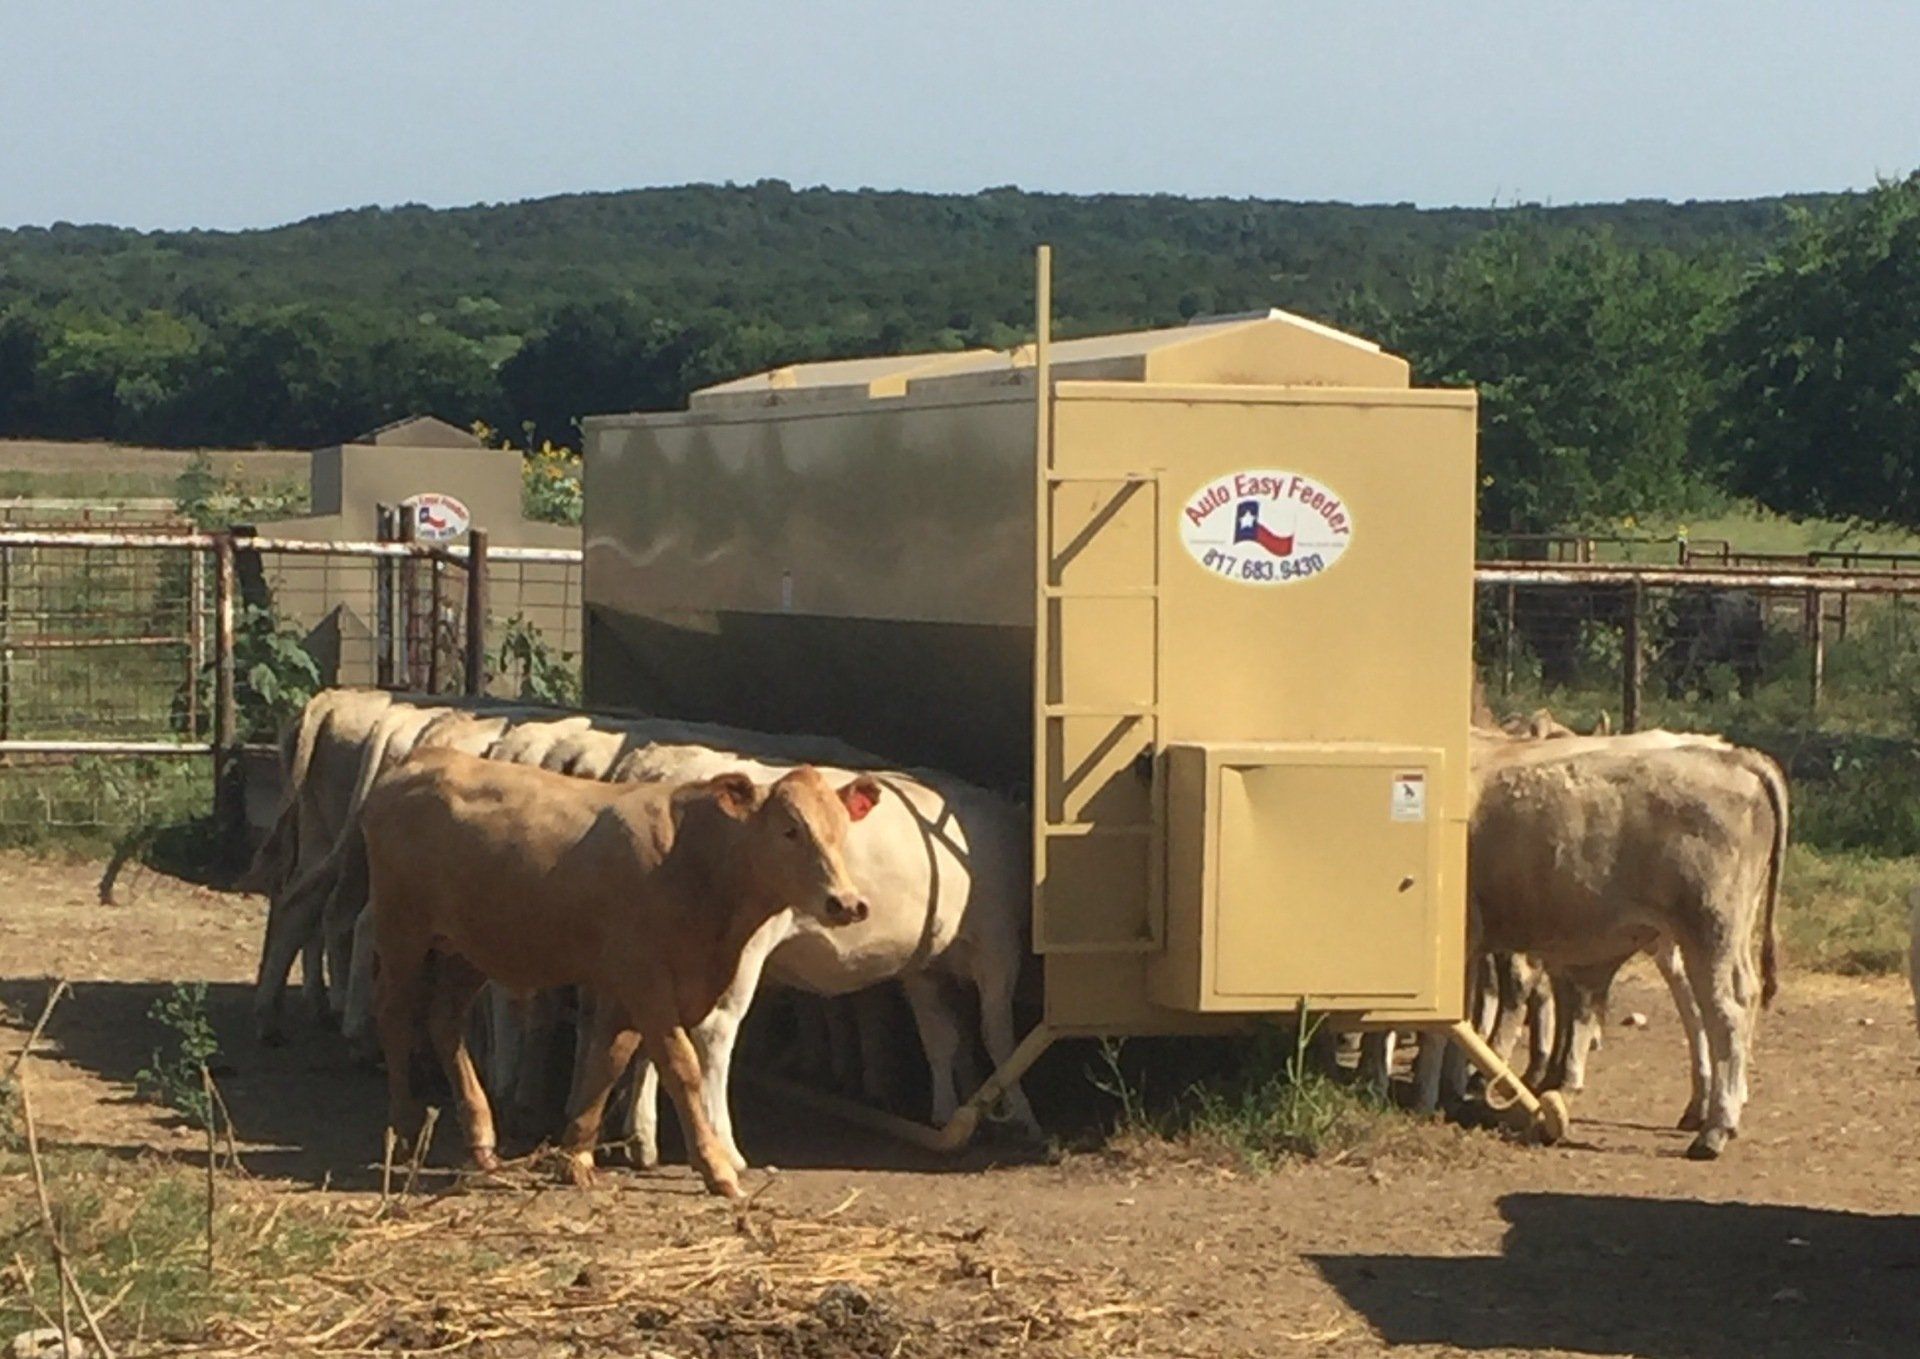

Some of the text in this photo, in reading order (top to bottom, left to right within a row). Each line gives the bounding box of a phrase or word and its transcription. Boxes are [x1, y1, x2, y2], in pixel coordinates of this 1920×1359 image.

[1185, 474, 1350, 535] Auto Easy Feeder
